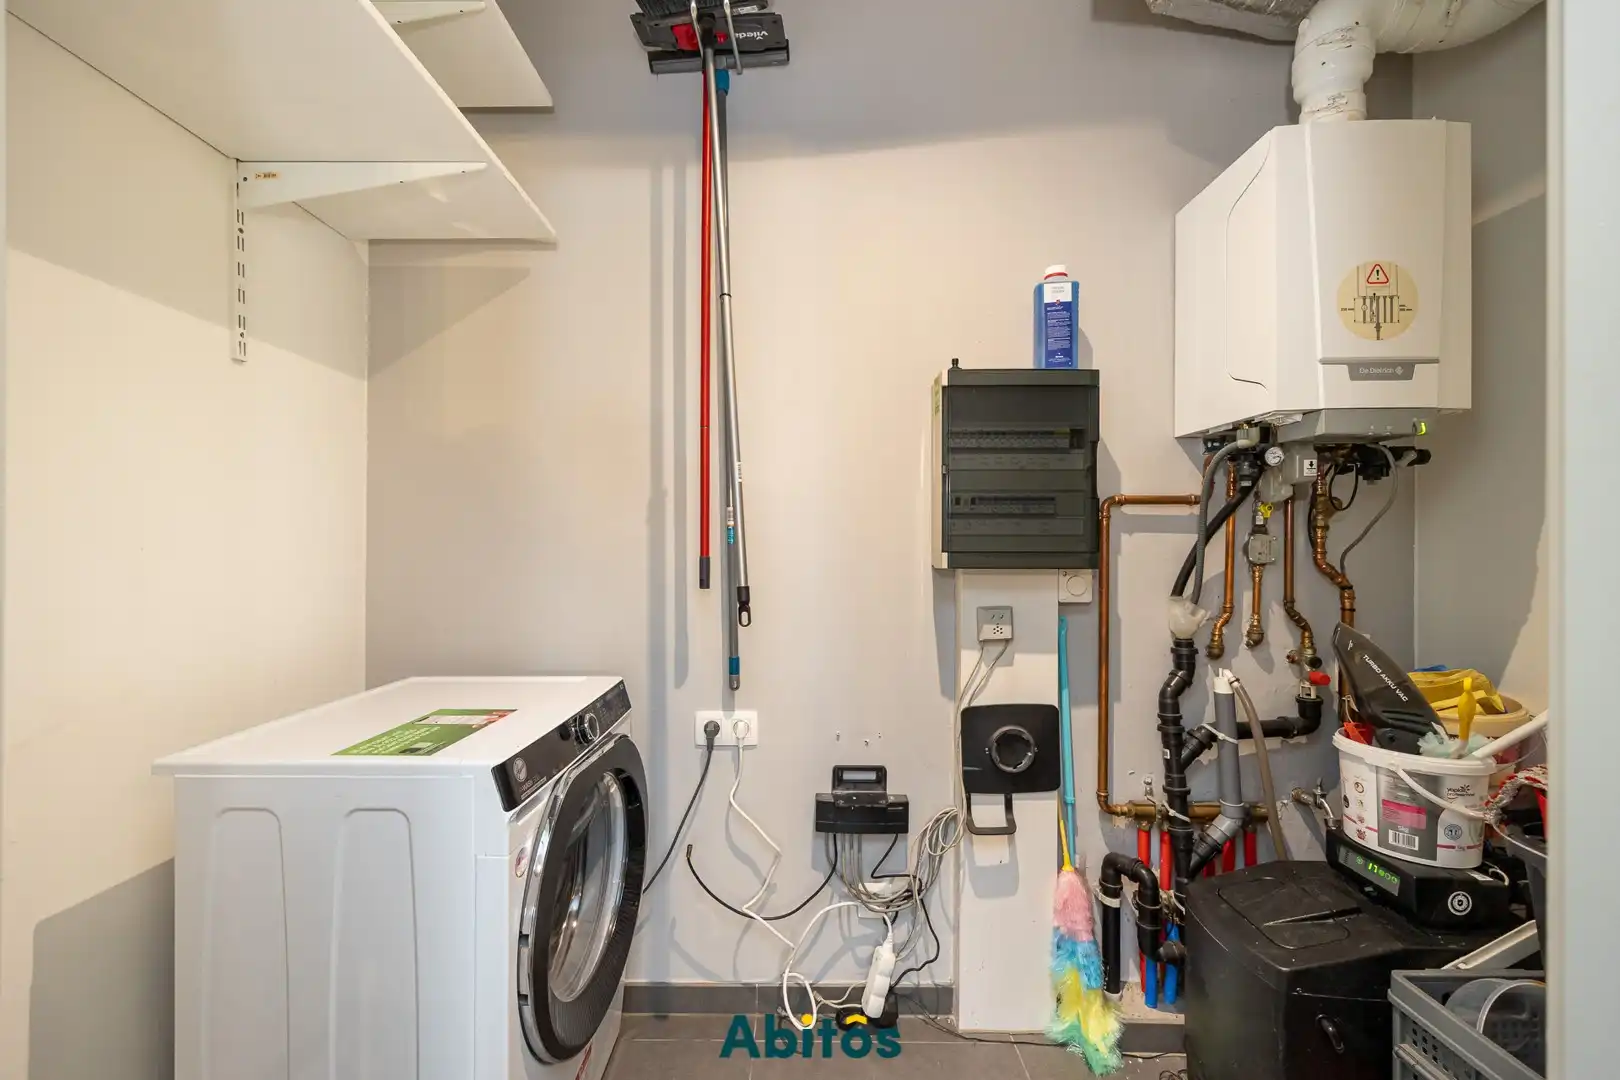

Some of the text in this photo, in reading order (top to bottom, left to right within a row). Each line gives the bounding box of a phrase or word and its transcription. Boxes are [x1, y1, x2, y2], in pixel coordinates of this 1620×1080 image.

[1362, 654, 1409, 702] TURBO AKKU VAC
